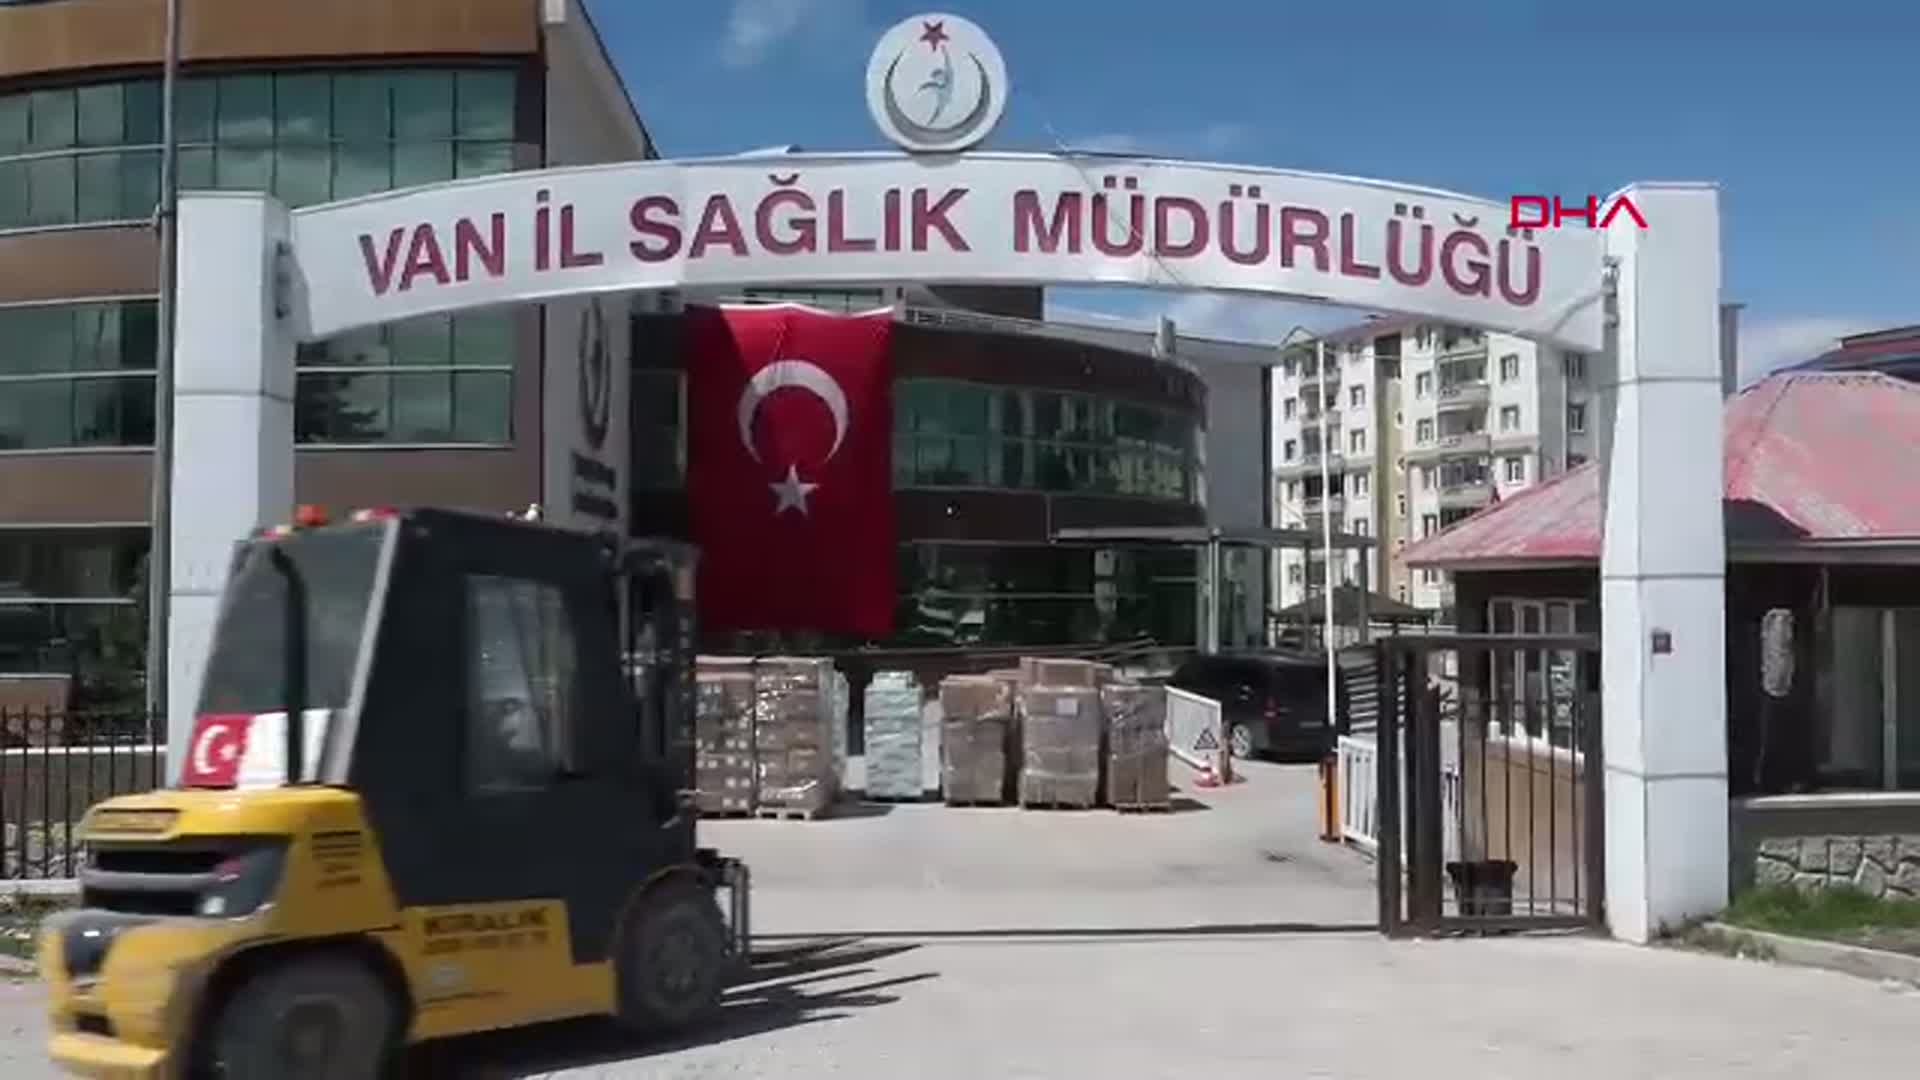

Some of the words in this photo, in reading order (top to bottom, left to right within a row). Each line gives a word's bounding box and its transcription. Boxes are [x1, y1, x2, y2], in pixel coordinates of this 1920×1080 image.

[359, 212, 506, 297] VAN
[534, 189, 605, 272] İL
[629, 174, 971, 264] SAĞLIK
[1012, 175, 1542, 306] MÜDÜRLÜĞÜ
